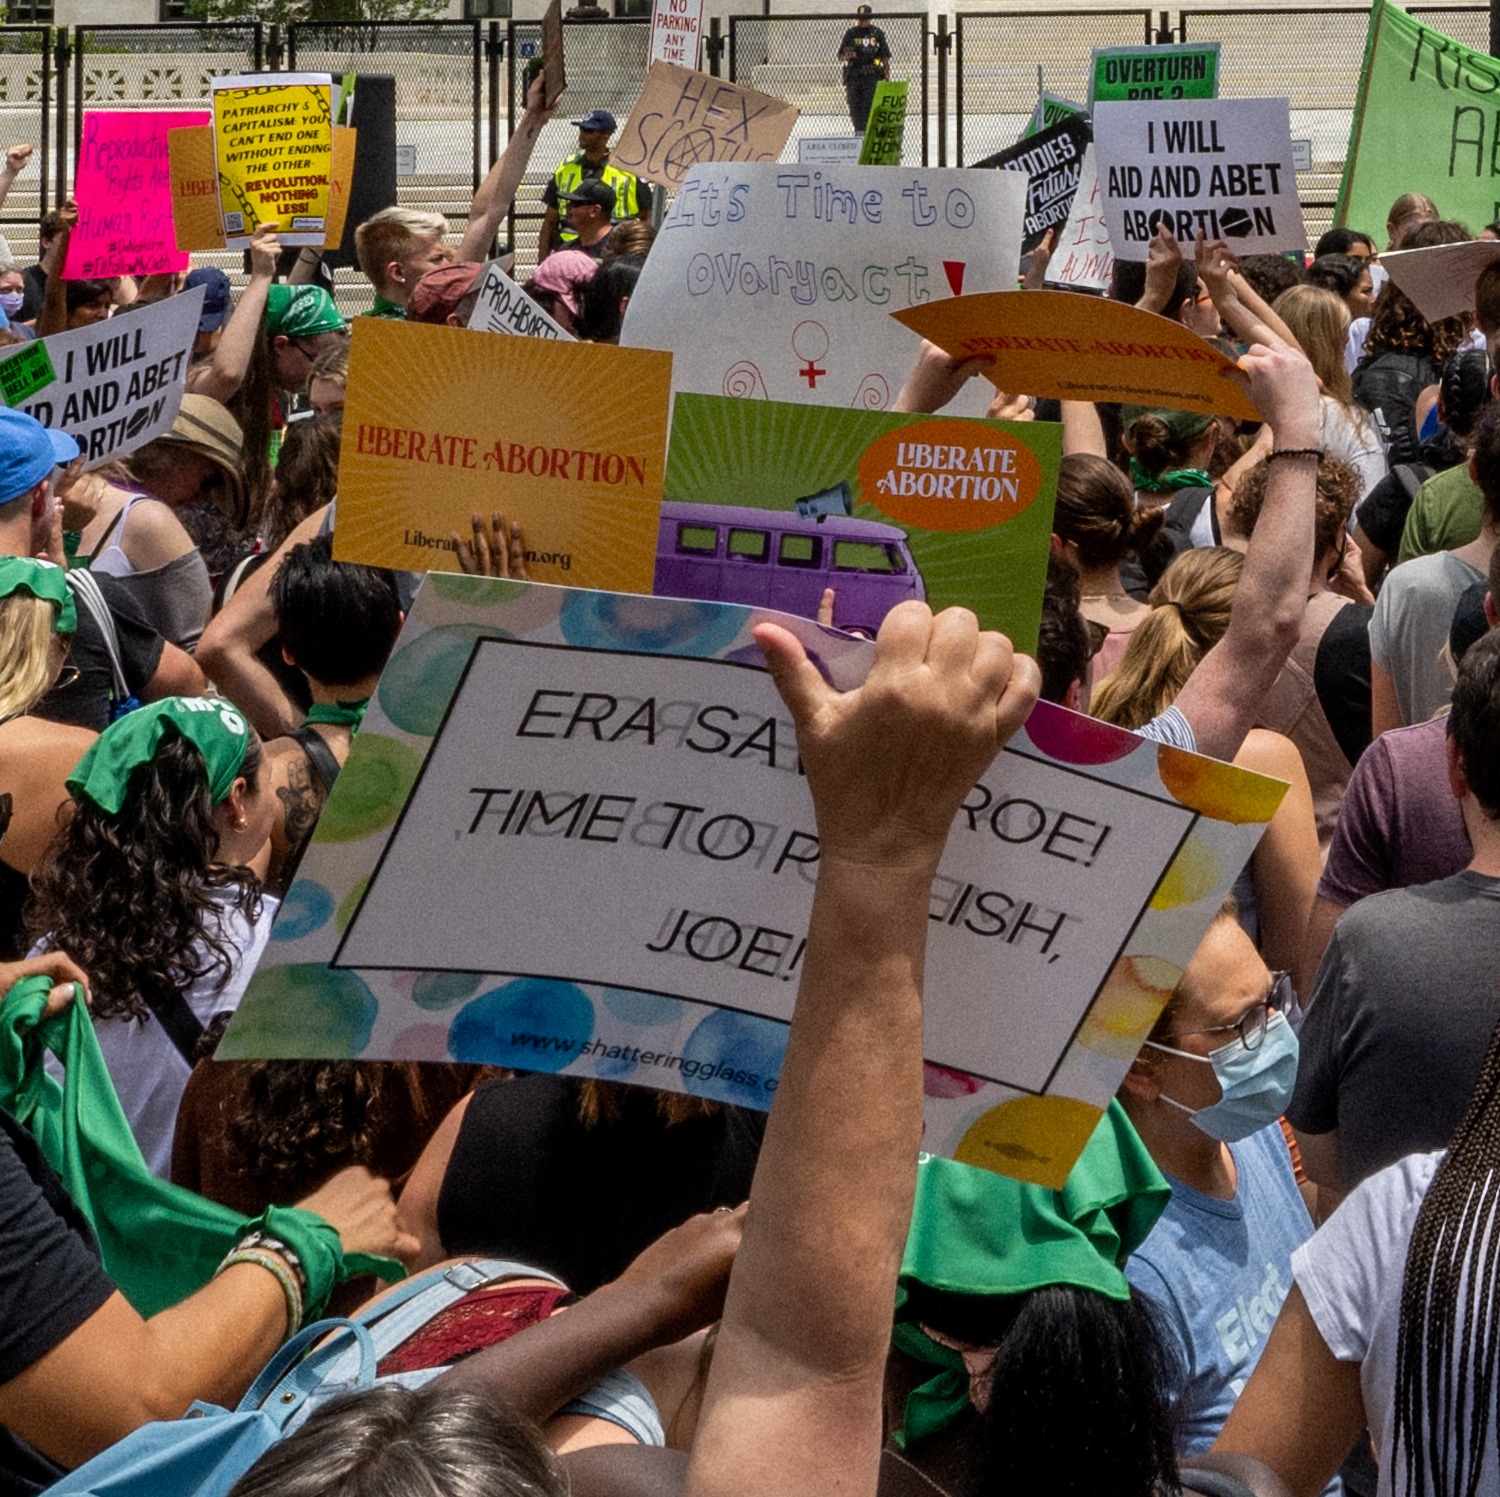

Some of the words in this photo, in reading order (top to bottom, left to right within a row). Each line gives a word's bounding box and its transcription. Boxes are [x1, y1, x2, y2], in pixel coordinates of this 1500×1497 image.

[656, 13, 697, 33] PARKING
[663, 47, 685, 61] TIME
[665, 33, 685, 46] ANY
[1105, 55, 1206, 84] OVERTURN
[222, 102, 299, 119] PATRIARCHY
[303, 101, 310, 111] &
[302, 115, 326, 126] YOU
[673, 77, 769, 142] HEX
[226, 147, 285, 163] WITHOUT
[288, 143, 331, 155] ENDING
[229, 134, 265, 147] CAN'T
[269, 131, 293, 143] END
[297, 129, 319, 140] ONE
[1148, 121, 1154, 154] I
[1163, 120, 1225, 154] WILL
[246, 163, 268, 174] THE
[1108, 165, 1142, 198] AID
[1148, 165, 1200, 198] AND
[1209, 163, 1281, 197] ABET
[260, 189, 318, 203] NOTHING
[277, 202, 308, 215] LESS!
[665, 176, 750, 230] It's
[777, 172, 883, 224] Time
[902, 180, 976, 229] to
[1123, 206, 1276, 242] ABORTION
[65, 350, 74, 384] I
[86, 328, 146, 377] WILL
[4, 375, 31, 399] HELL
[60, 380, 120, 428] AND
[124, 349, 186, 406] ABET
[356, 424, 478, 470] LIBERATE
[483, 440, 647, 487] ABORTION
[896, 442, 1018, 474] LIBERATE
[877, 469, 1019, 503] ABORTION
[516, 689, 657, 746] ERA
[957, 782, 1111, 868] ROE!
[465, 787, 637, 844] TIME
[663, 800, 755, 861] TO
[645, 908, 808, 982] JOE!
